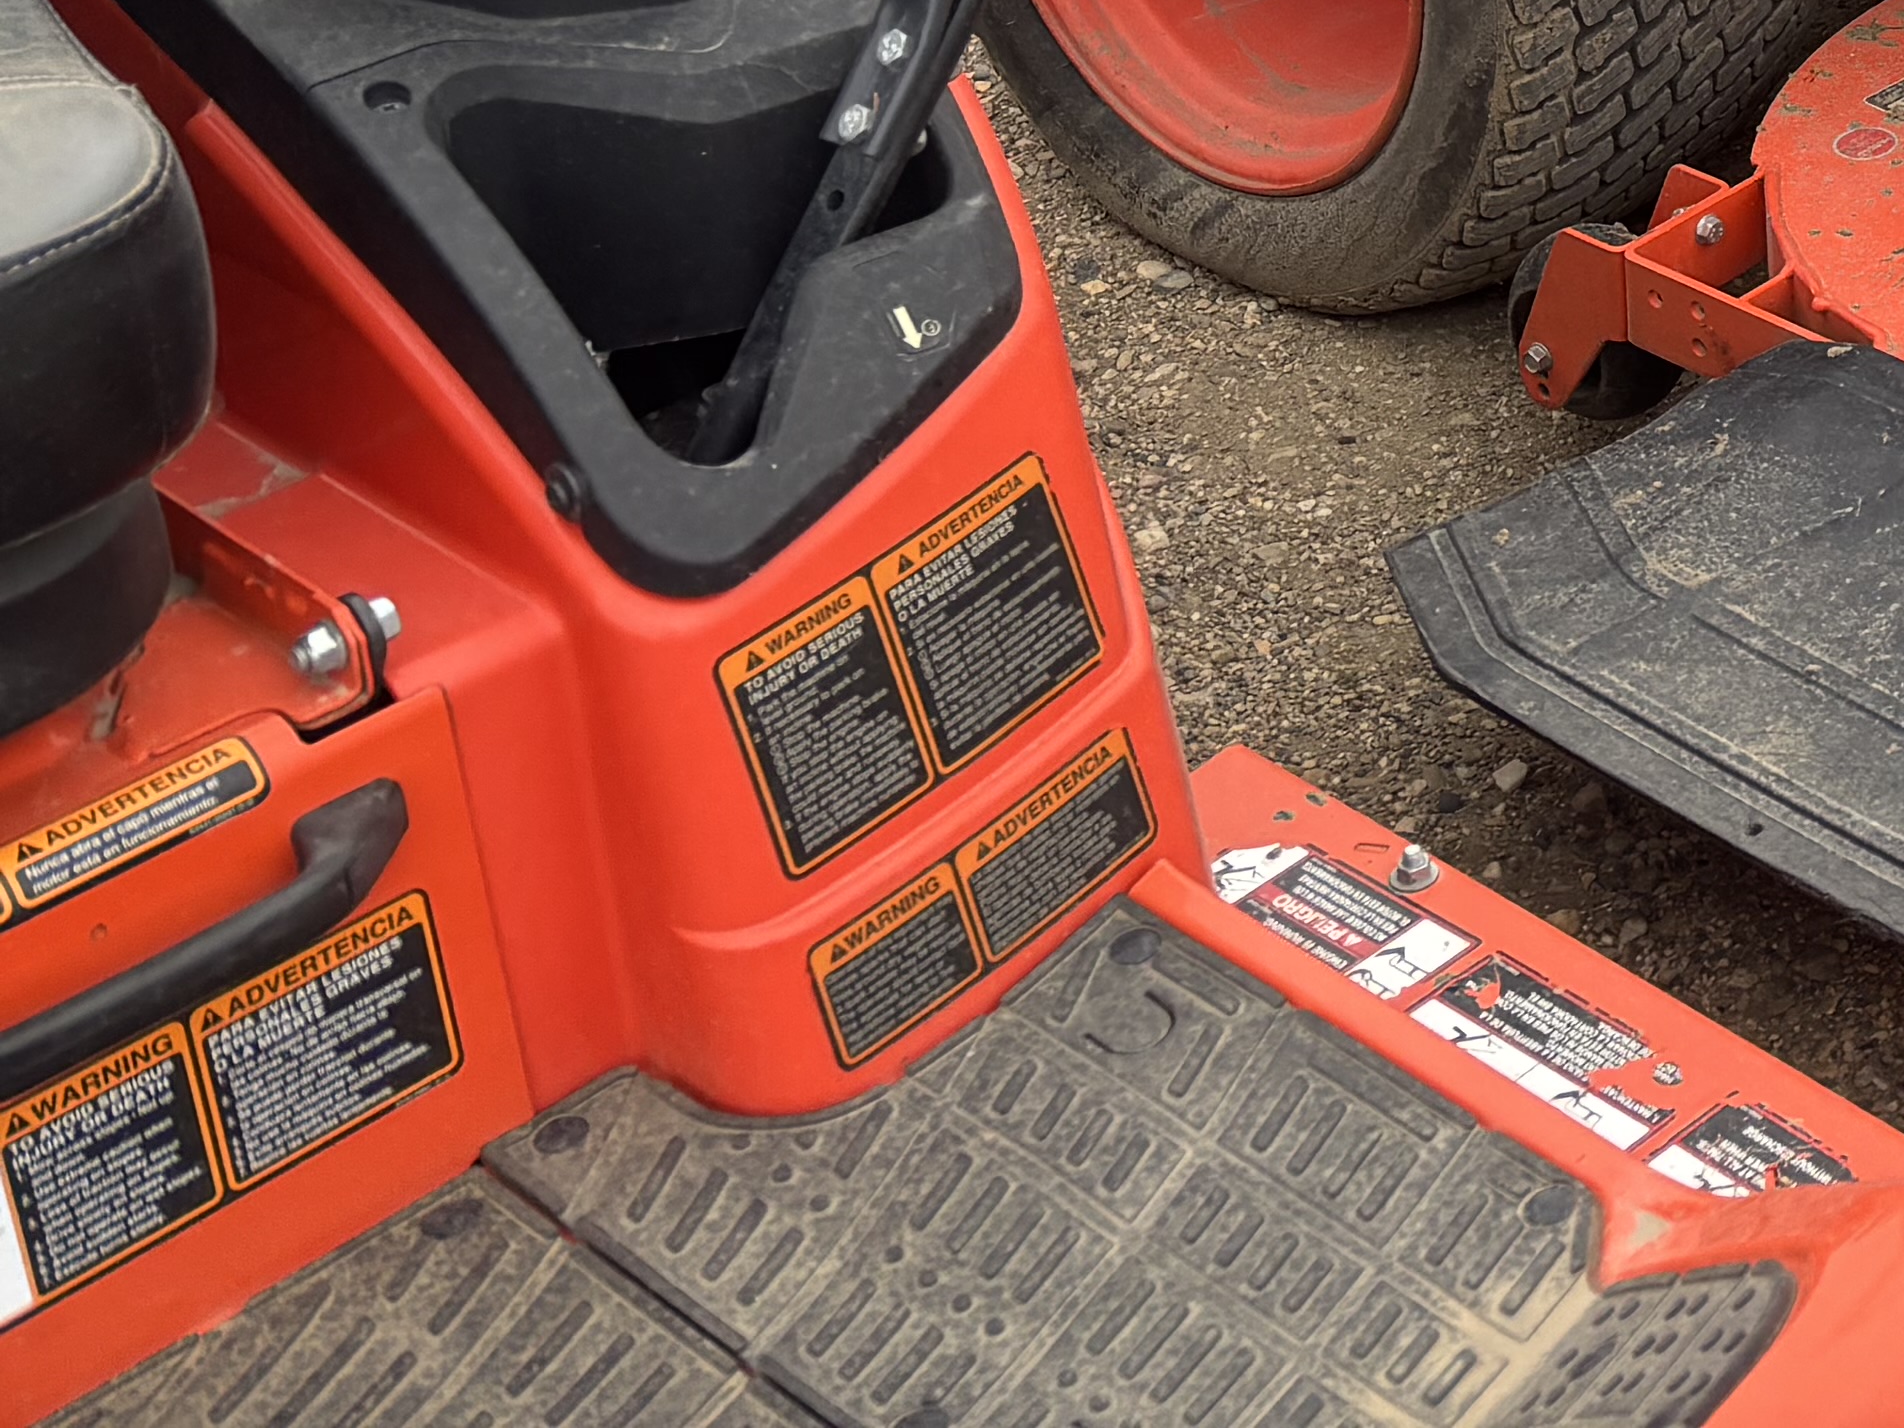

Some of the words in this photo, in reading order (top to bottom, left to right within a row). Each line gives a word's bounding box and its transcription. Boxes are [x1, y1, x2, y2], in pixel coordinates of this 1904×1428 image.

[919, 473, 1025, 559] ADVERTENCIA
[763, 592, 853, 655] WARNING
[909, 597, 928, 615] LA
[743, 675, 765, 693] TO
[766, 648, 806, 682] AVOID
[820, 626, 865, 661] DEATH
[45, 746, 233, 848] ADVERTENCIA
[990, 745, 1114, 847] ADVERTENCIA
[847, 875, 942, 950] WARNING
[1272, 894, 1346, 942] PELIGRO
[227, 905, 415, 1020] ADVERTENCIA
[319, 934, 404, 987] LESIONES
[30, 1031, 174, 1122] WARNING
